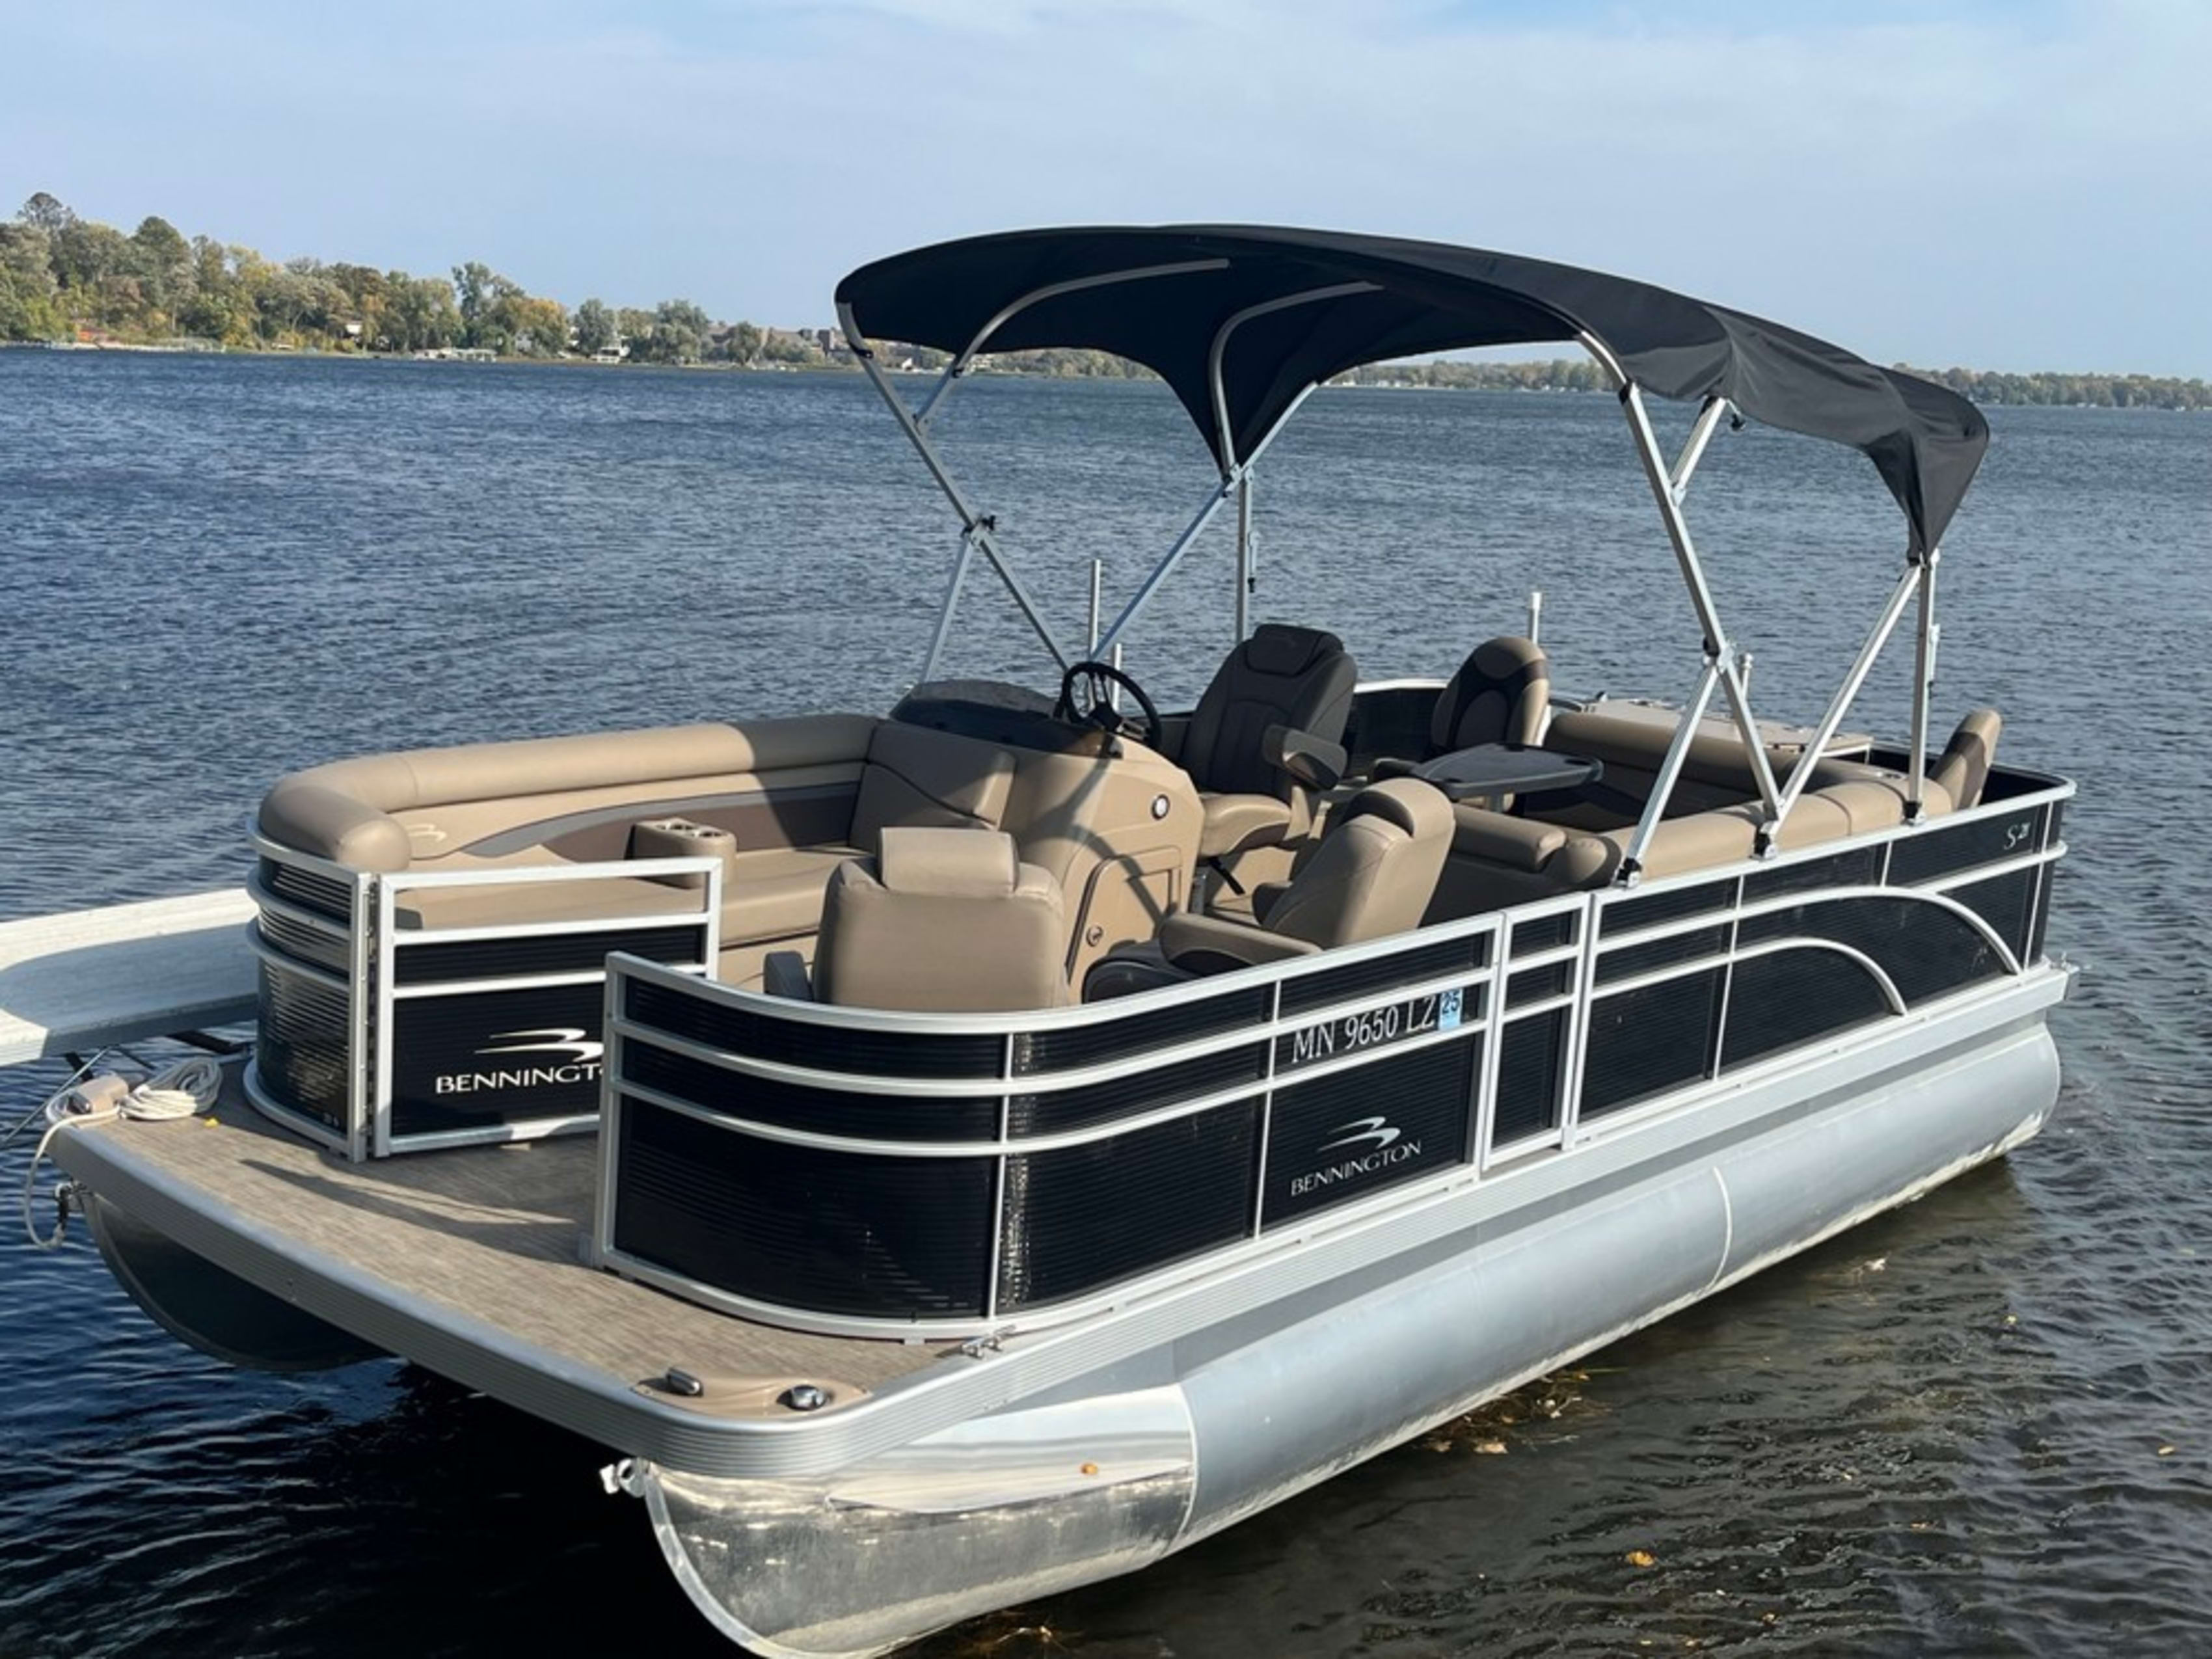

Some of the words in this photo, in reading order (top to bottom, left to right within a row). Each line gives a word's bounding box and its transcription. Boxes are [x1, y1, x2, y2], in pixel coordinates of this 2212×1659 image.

[1442, 990, 1461, 1015] 25
[1291, 1022, 1334, 1064] MN
[1343, 1006, 1399, 1050] 9650
[1406, 994, 1436, 1033] LZ
[435, 1063, 604, 1094] BENNINGT
[1291, 1140, 1422, 1197] BENNINGTON
